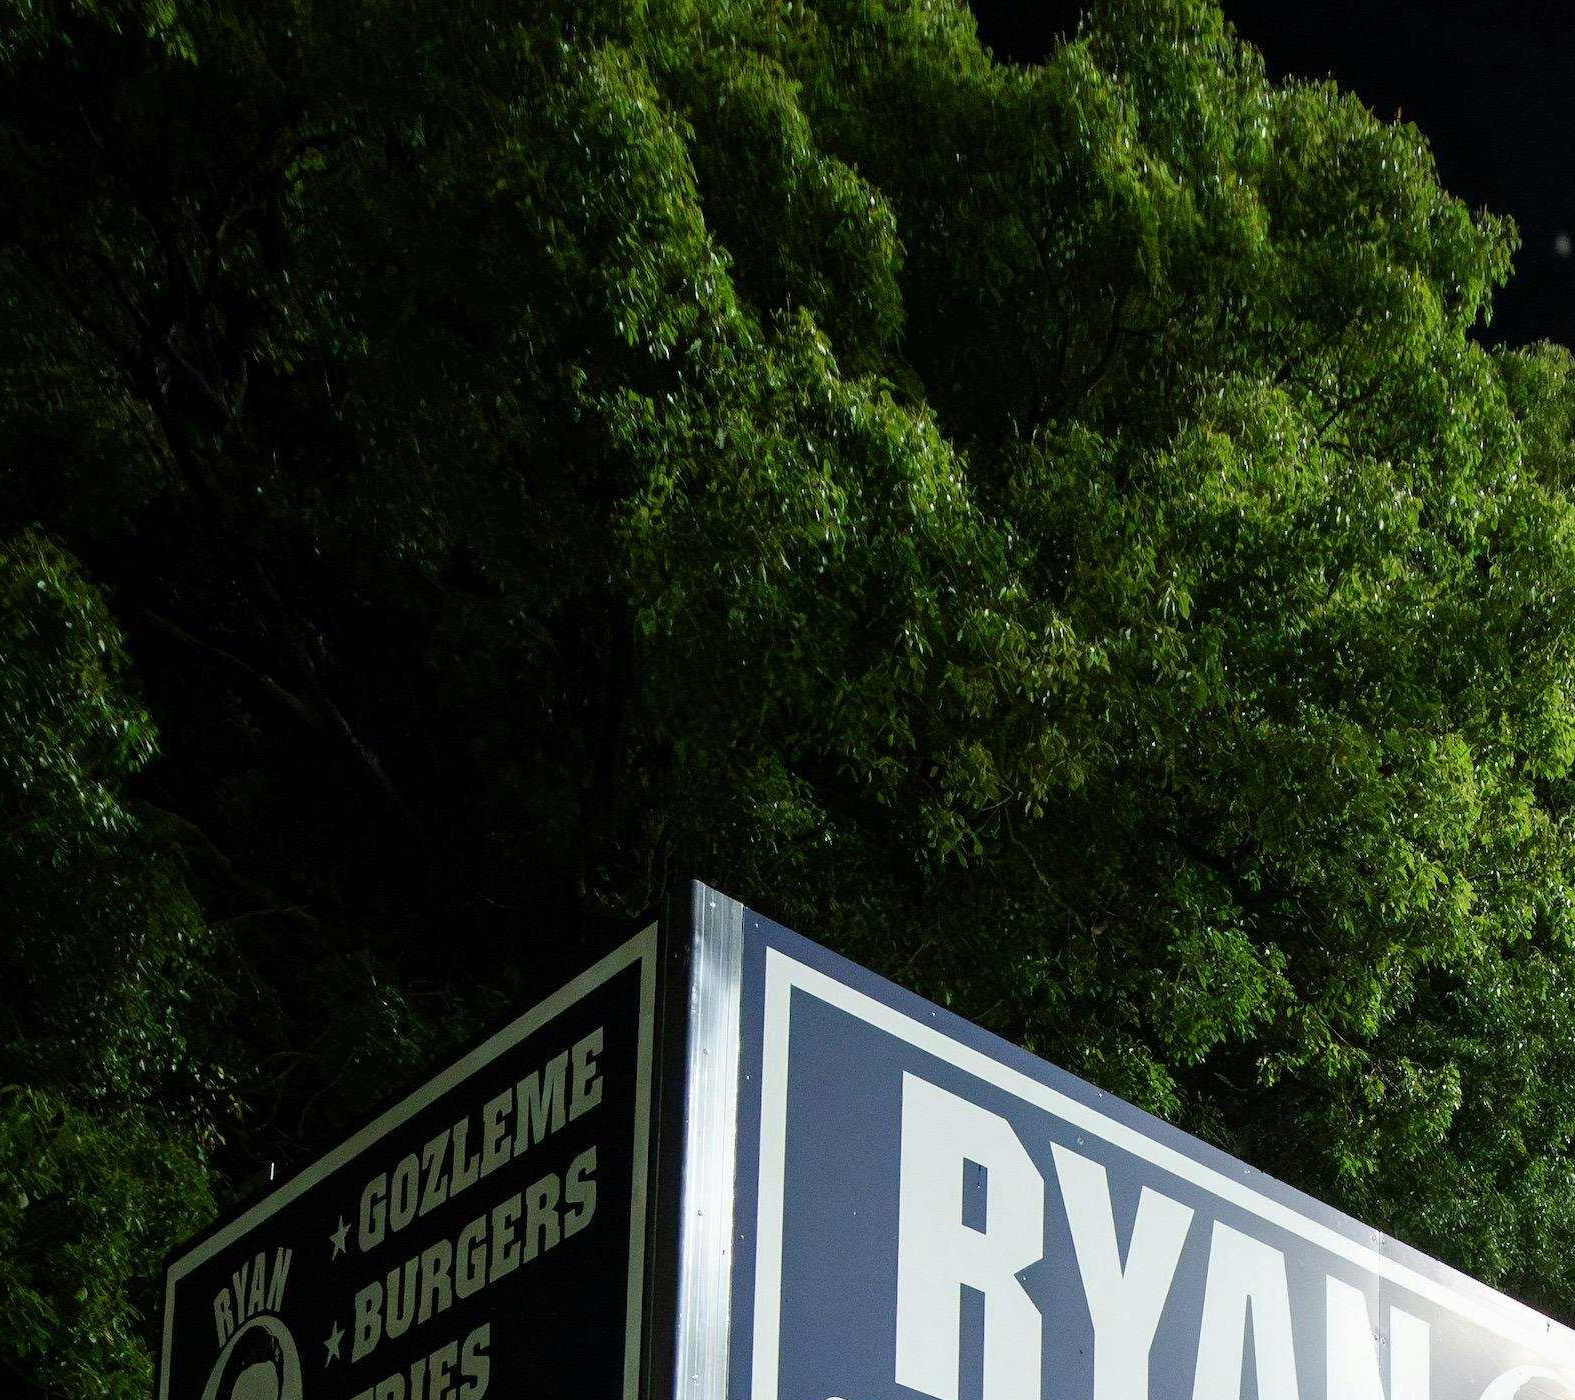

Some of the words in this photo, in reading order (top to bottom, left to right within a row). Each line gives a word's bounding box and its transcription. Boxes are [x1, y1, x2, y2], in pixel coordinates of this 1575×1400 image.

[359, 1026, 605, 1253] GOZLEME
[213, 1246, 292, 1348] RYAN
[352, 1145, 598, 1363] BURGERS
